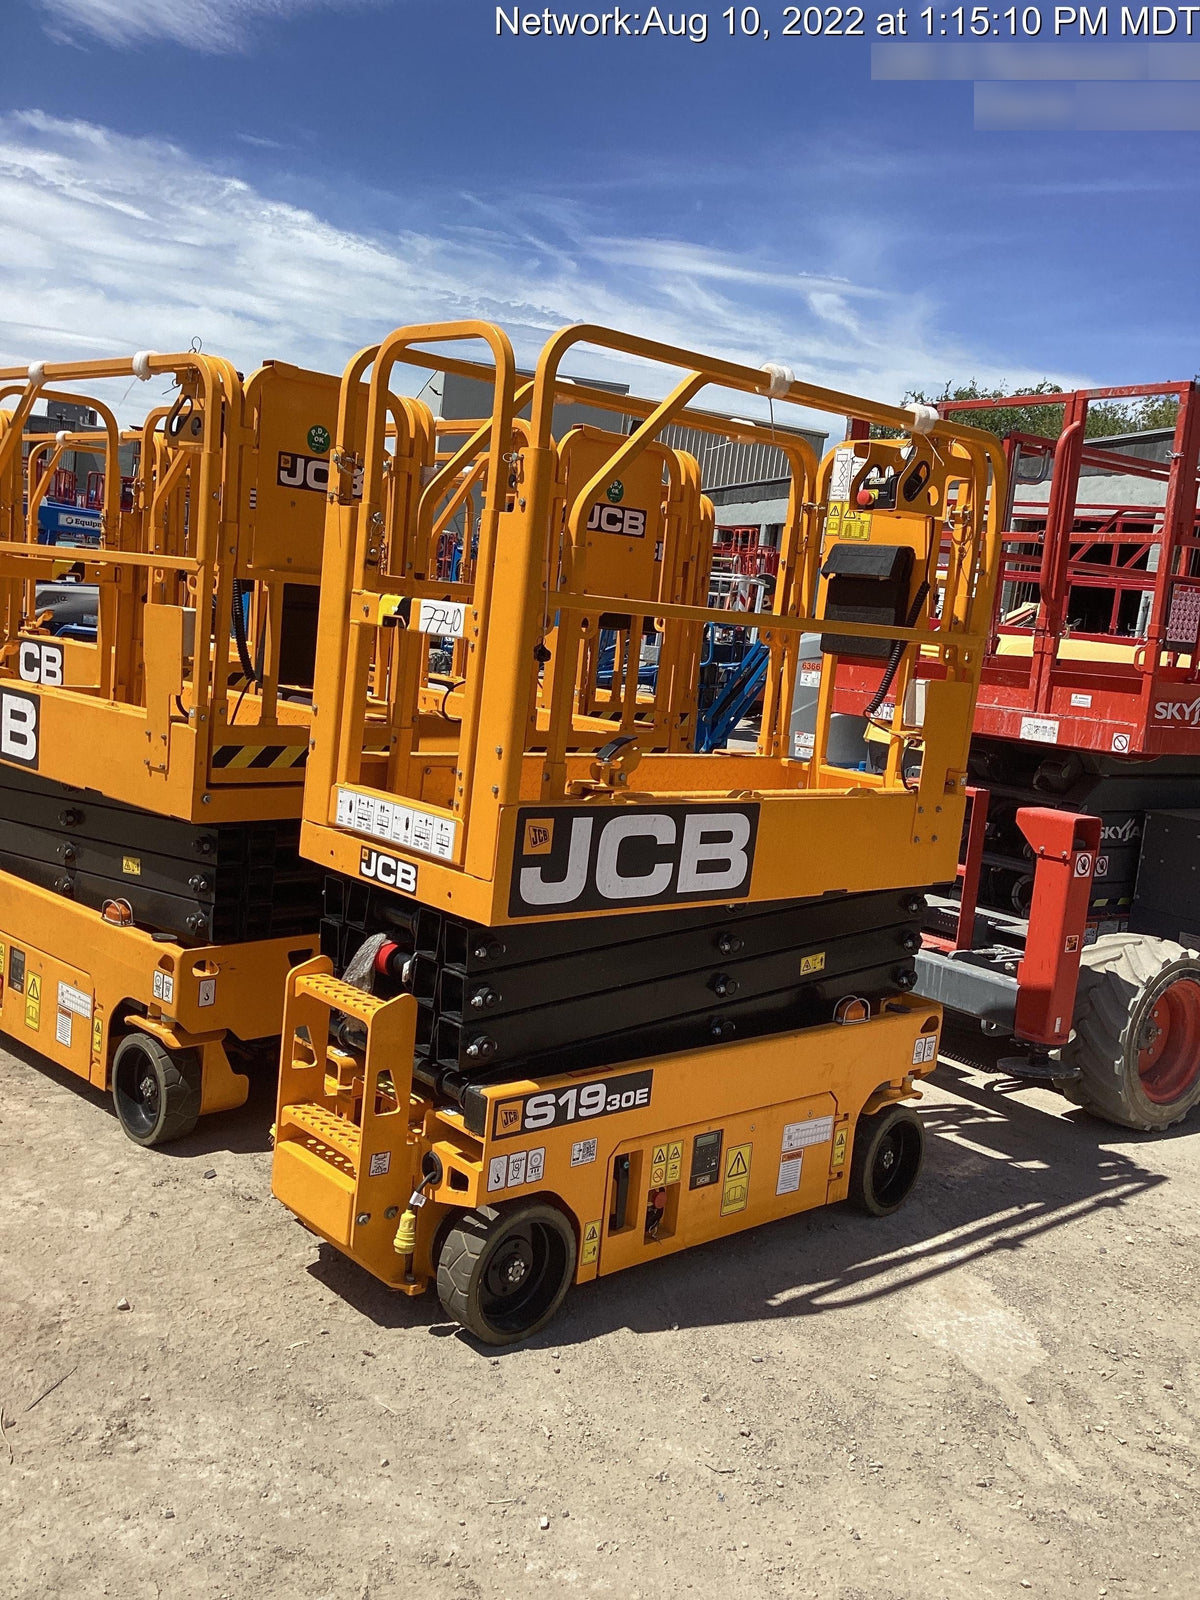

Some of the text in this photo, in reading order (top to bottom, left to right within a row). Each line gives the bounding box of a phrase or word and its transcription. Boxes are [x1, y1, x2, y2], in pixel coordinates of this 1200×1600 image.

[587, 505, 645, 536] JCB
[528, 826, 548, 847] JCB
[360, 851, 417, 893] JCB
[519, 812, 751, 906] JCB
